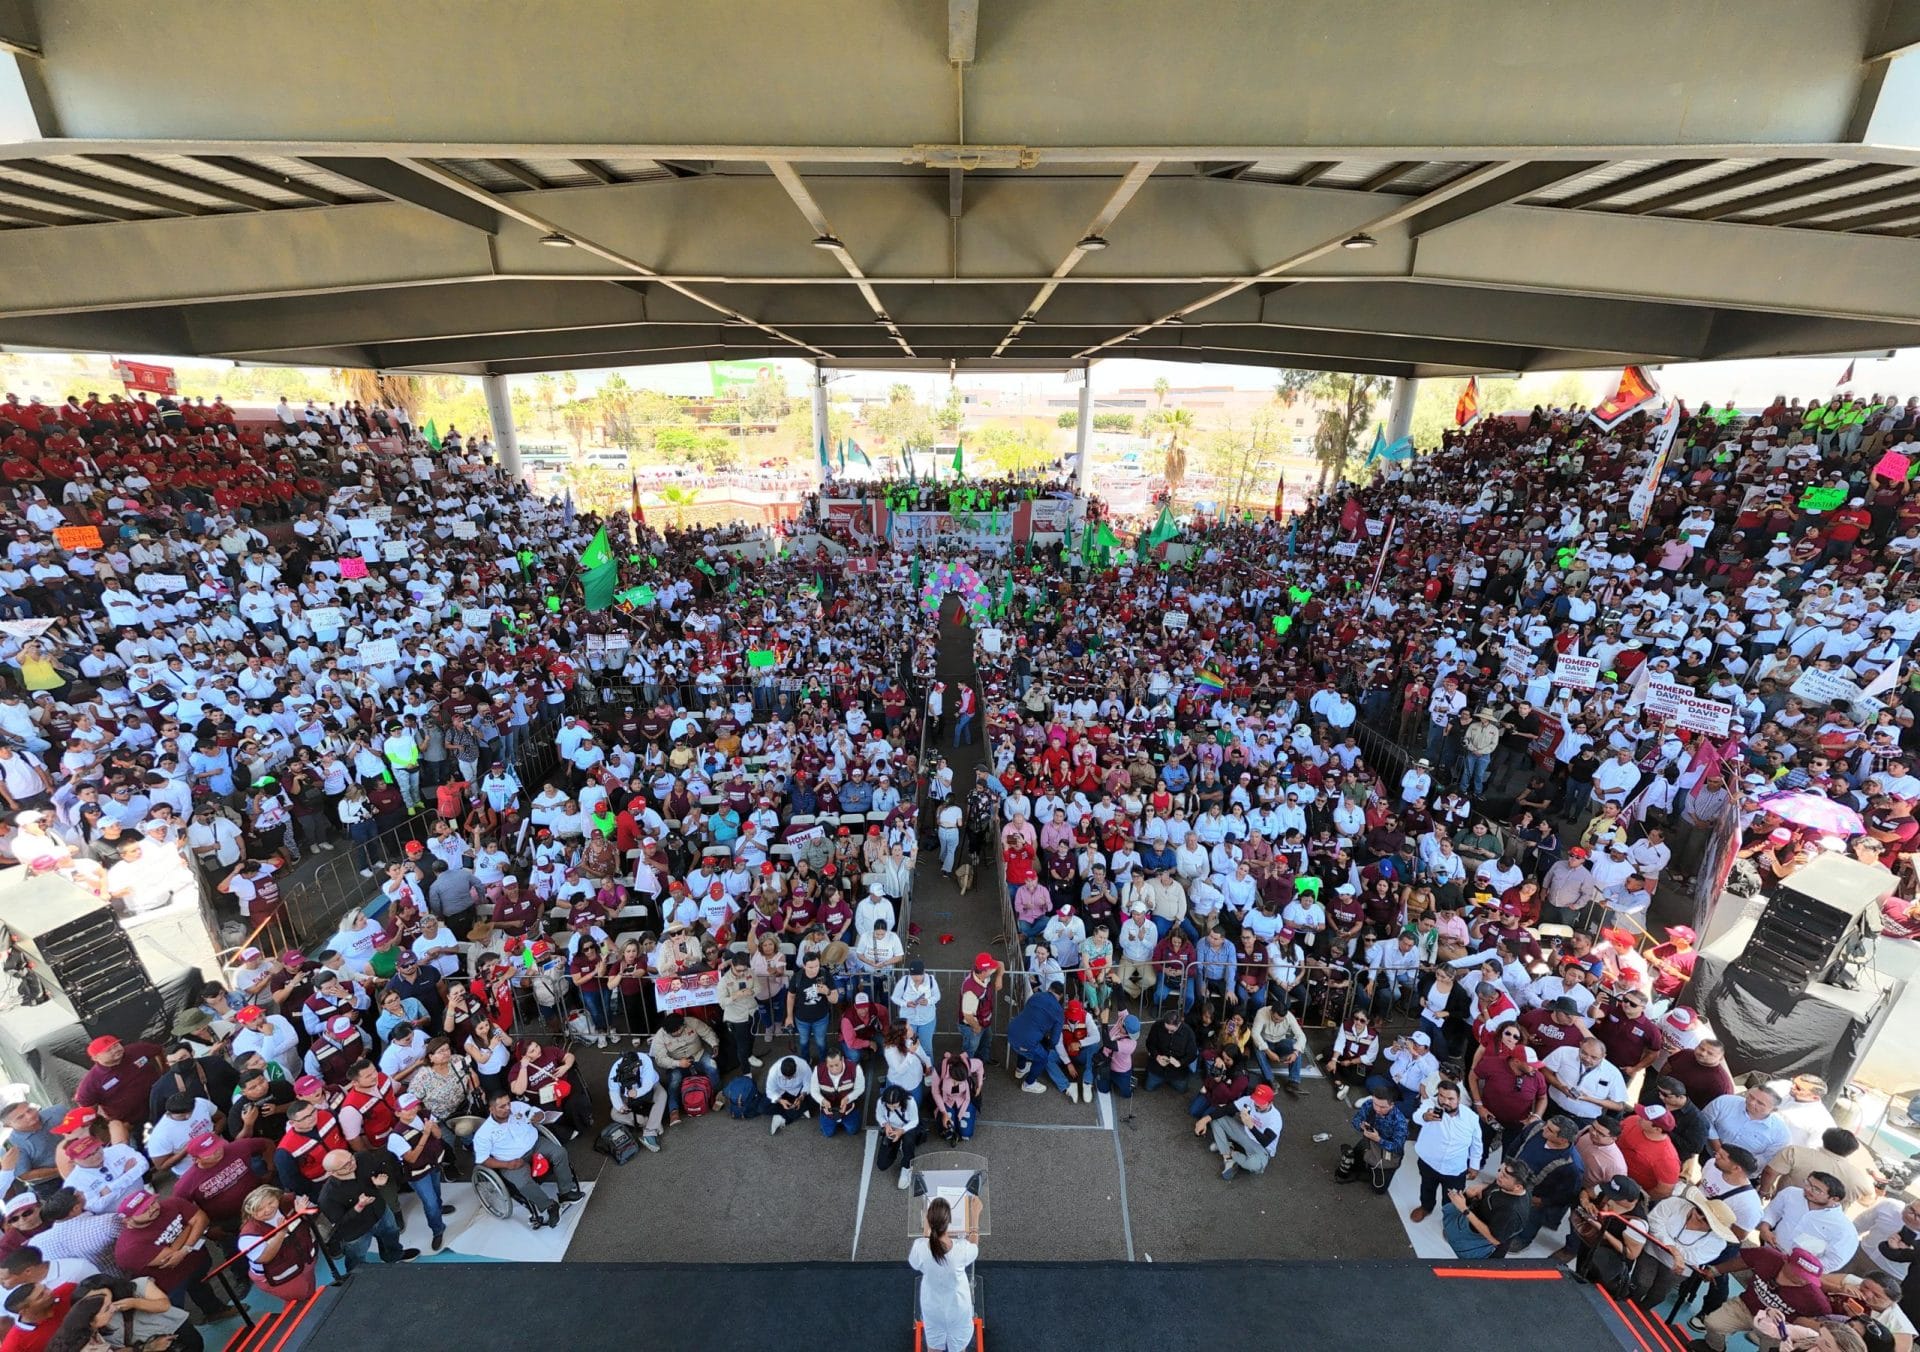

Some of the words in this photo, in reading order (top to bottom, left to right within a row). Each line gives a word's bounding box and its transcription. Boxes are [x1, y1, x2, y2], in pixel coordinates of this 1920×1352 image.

[1557, 656, 1600, 669] HOMERO
[1564, 664, 1590, 673] DAVIS
[1648, 681, 1694, 697] HOMERO
[1679, 698, 1731, 715] HOMERO
[1687, 706, 1719, 719] DAVIS
[1680, 719, 1711, 732] morena
